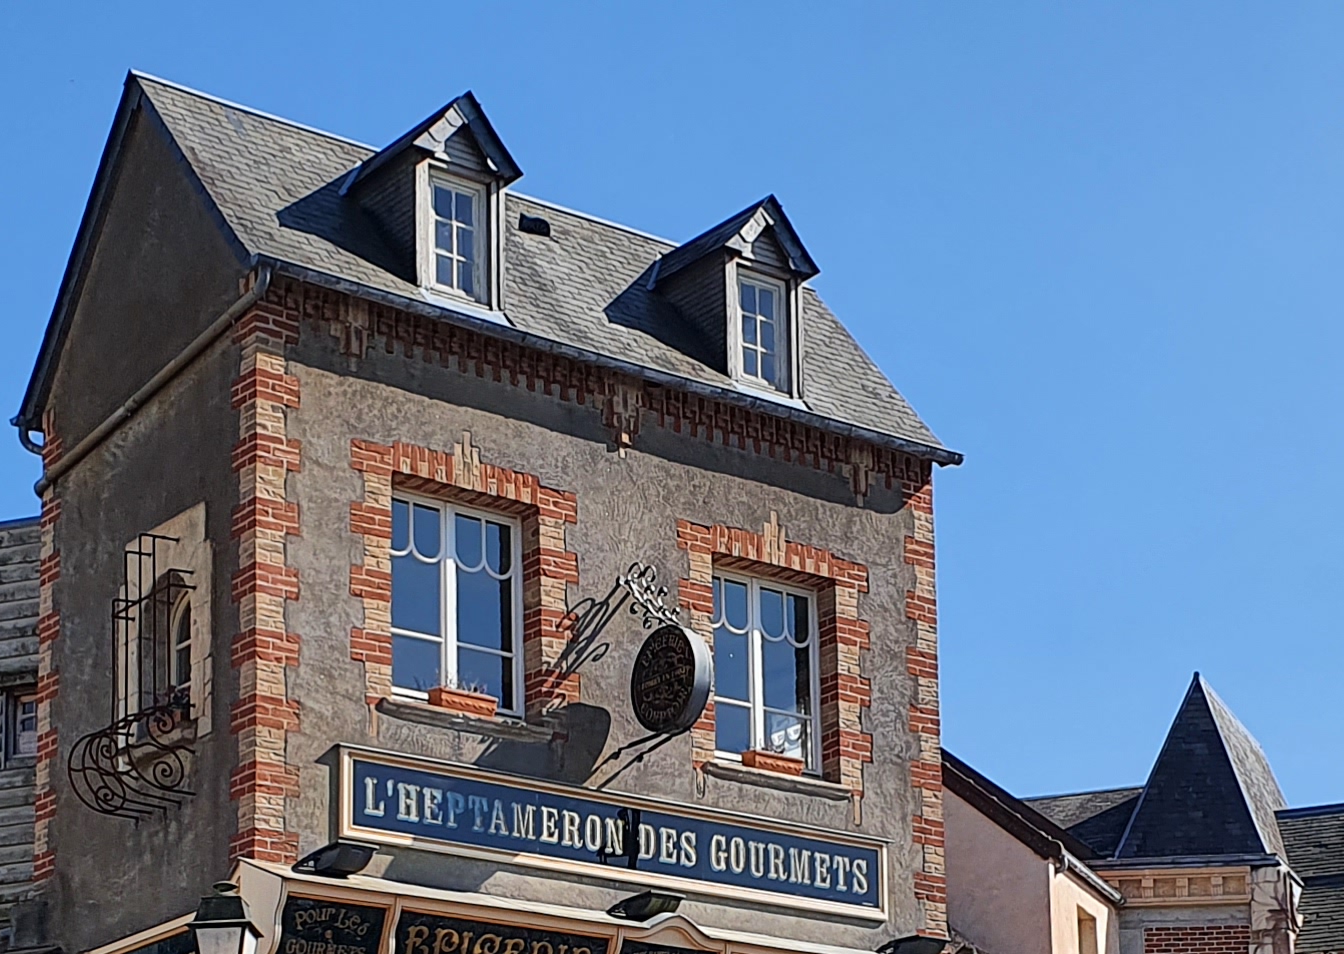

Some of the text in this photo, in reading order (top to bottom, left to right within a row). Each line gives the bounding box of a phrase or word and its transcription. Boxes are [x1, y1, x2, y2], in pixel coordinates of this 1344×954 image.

[364, 776, 868, 895] L'HEPTAMERON DES GOURMETS
